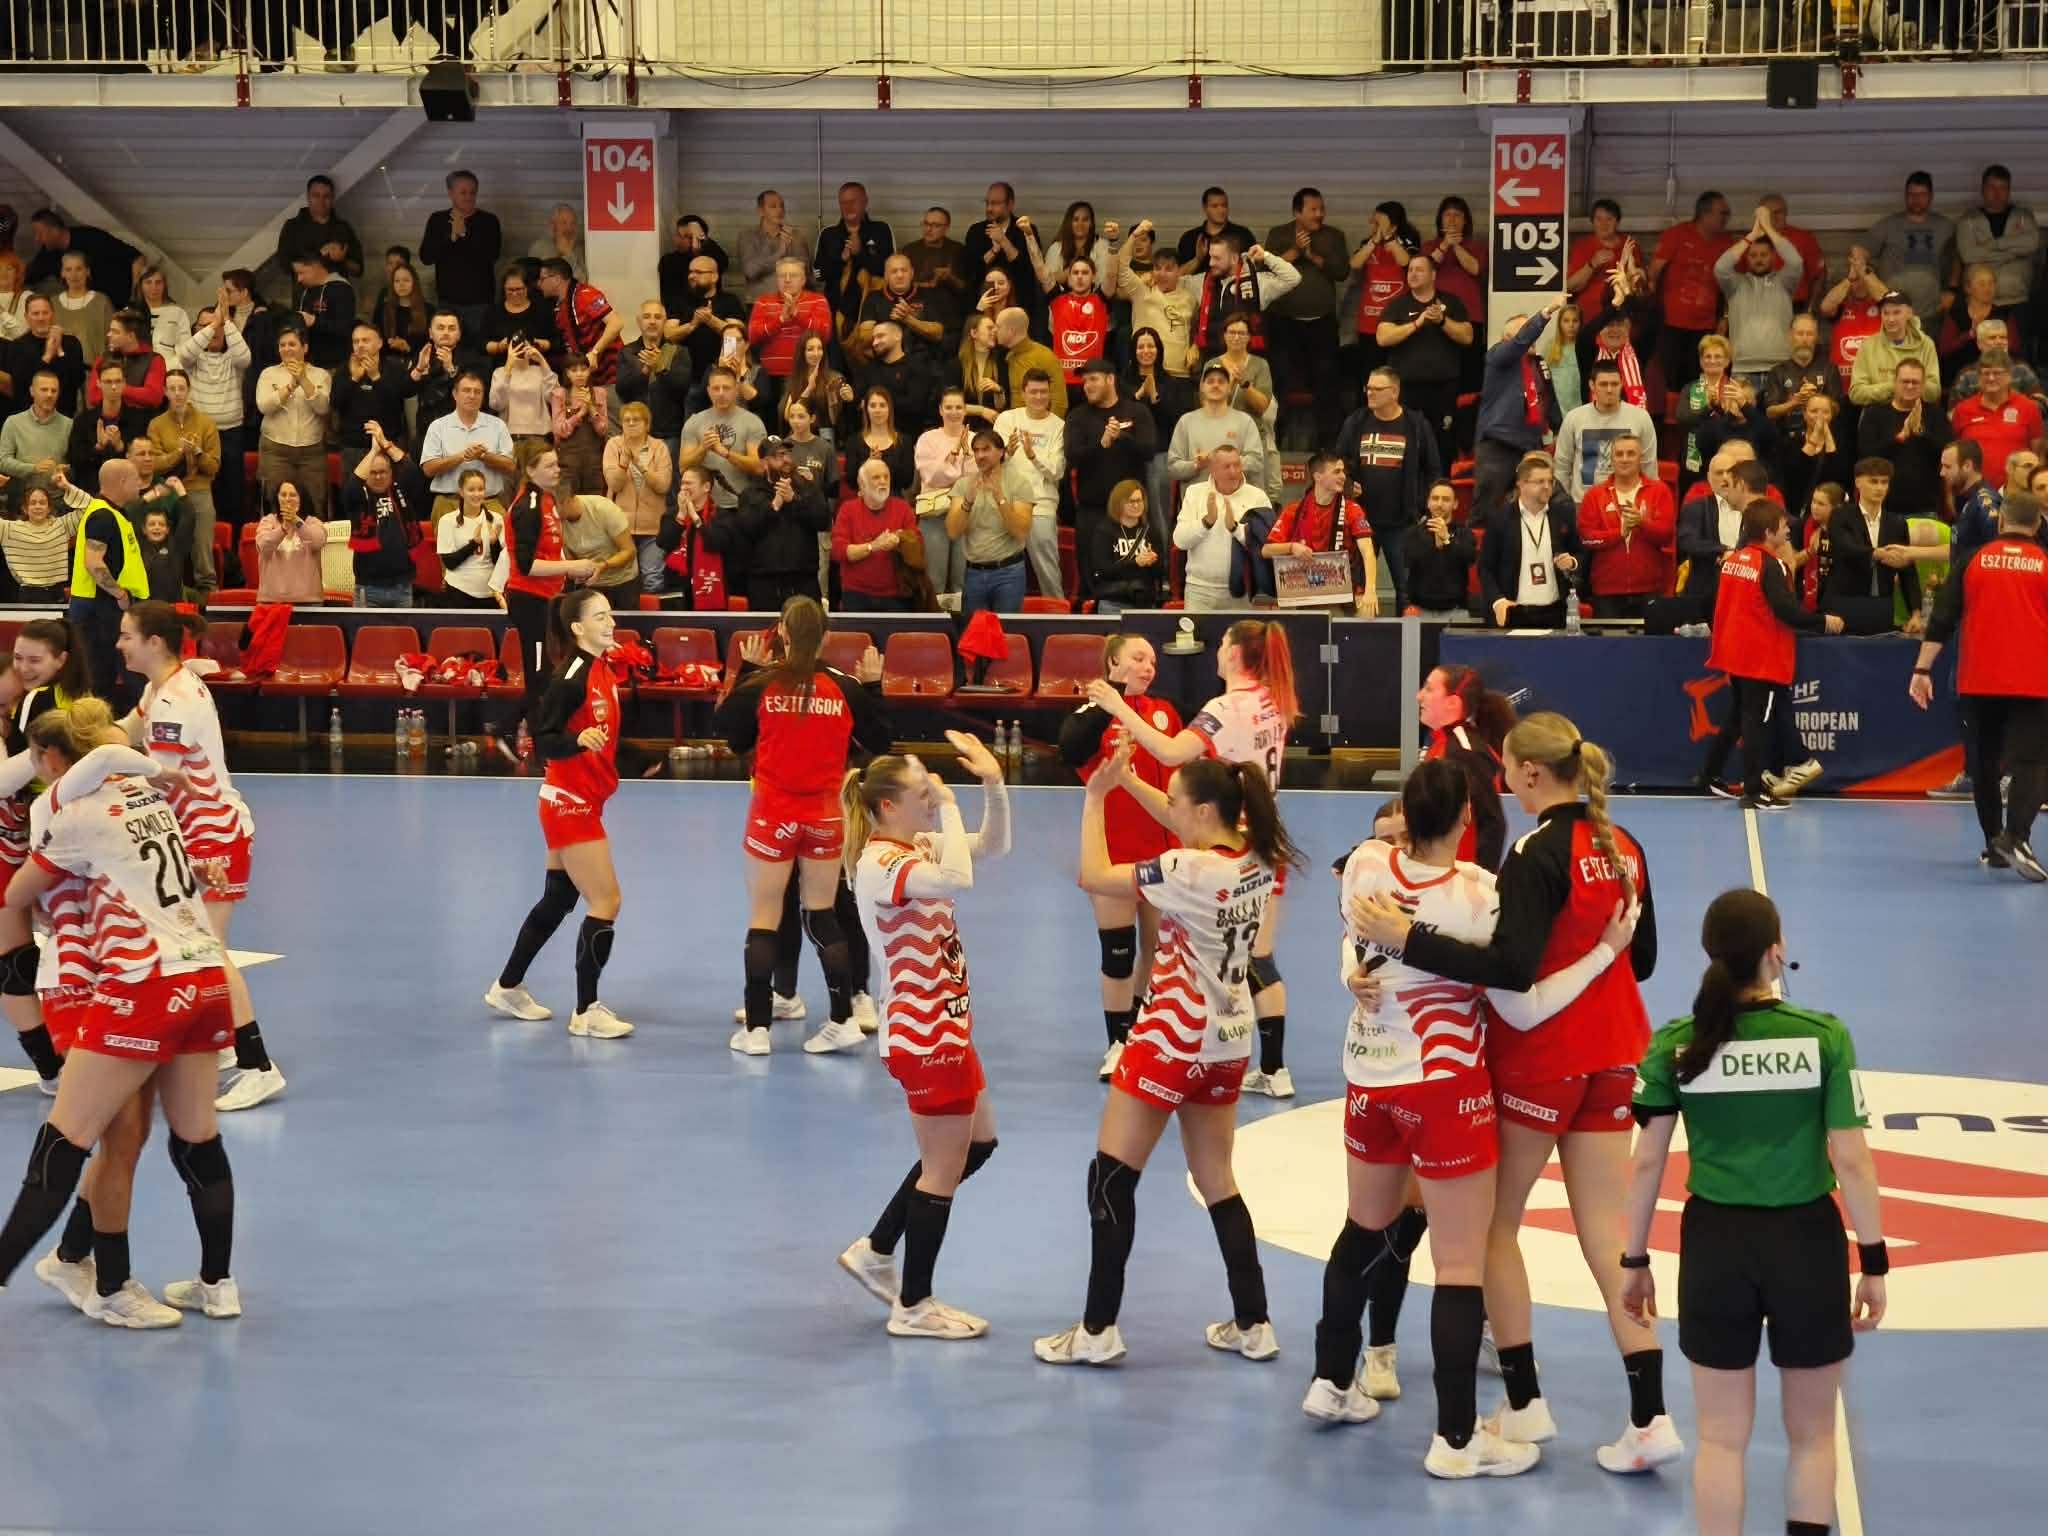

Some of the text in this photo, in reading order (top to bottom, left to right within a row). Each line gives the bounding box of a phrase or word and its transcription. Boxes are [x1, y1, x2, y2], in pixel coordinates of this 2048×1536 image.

[587, 144, 651, 173] 104
[1497, 142, 1563, 171] 104
[1498, 222, 1561, 251] 103
[1981, 554, 2044, 573] ESZTERGOM
[1790, 680, 1820, 698] HF
[126, 791, 164, 810] SUZUK
[139, 832, 197, 908] 20
[1232, 874, 1273, 898] SUZUK
[1721, 1052, 1813, 1077] DEKRA
